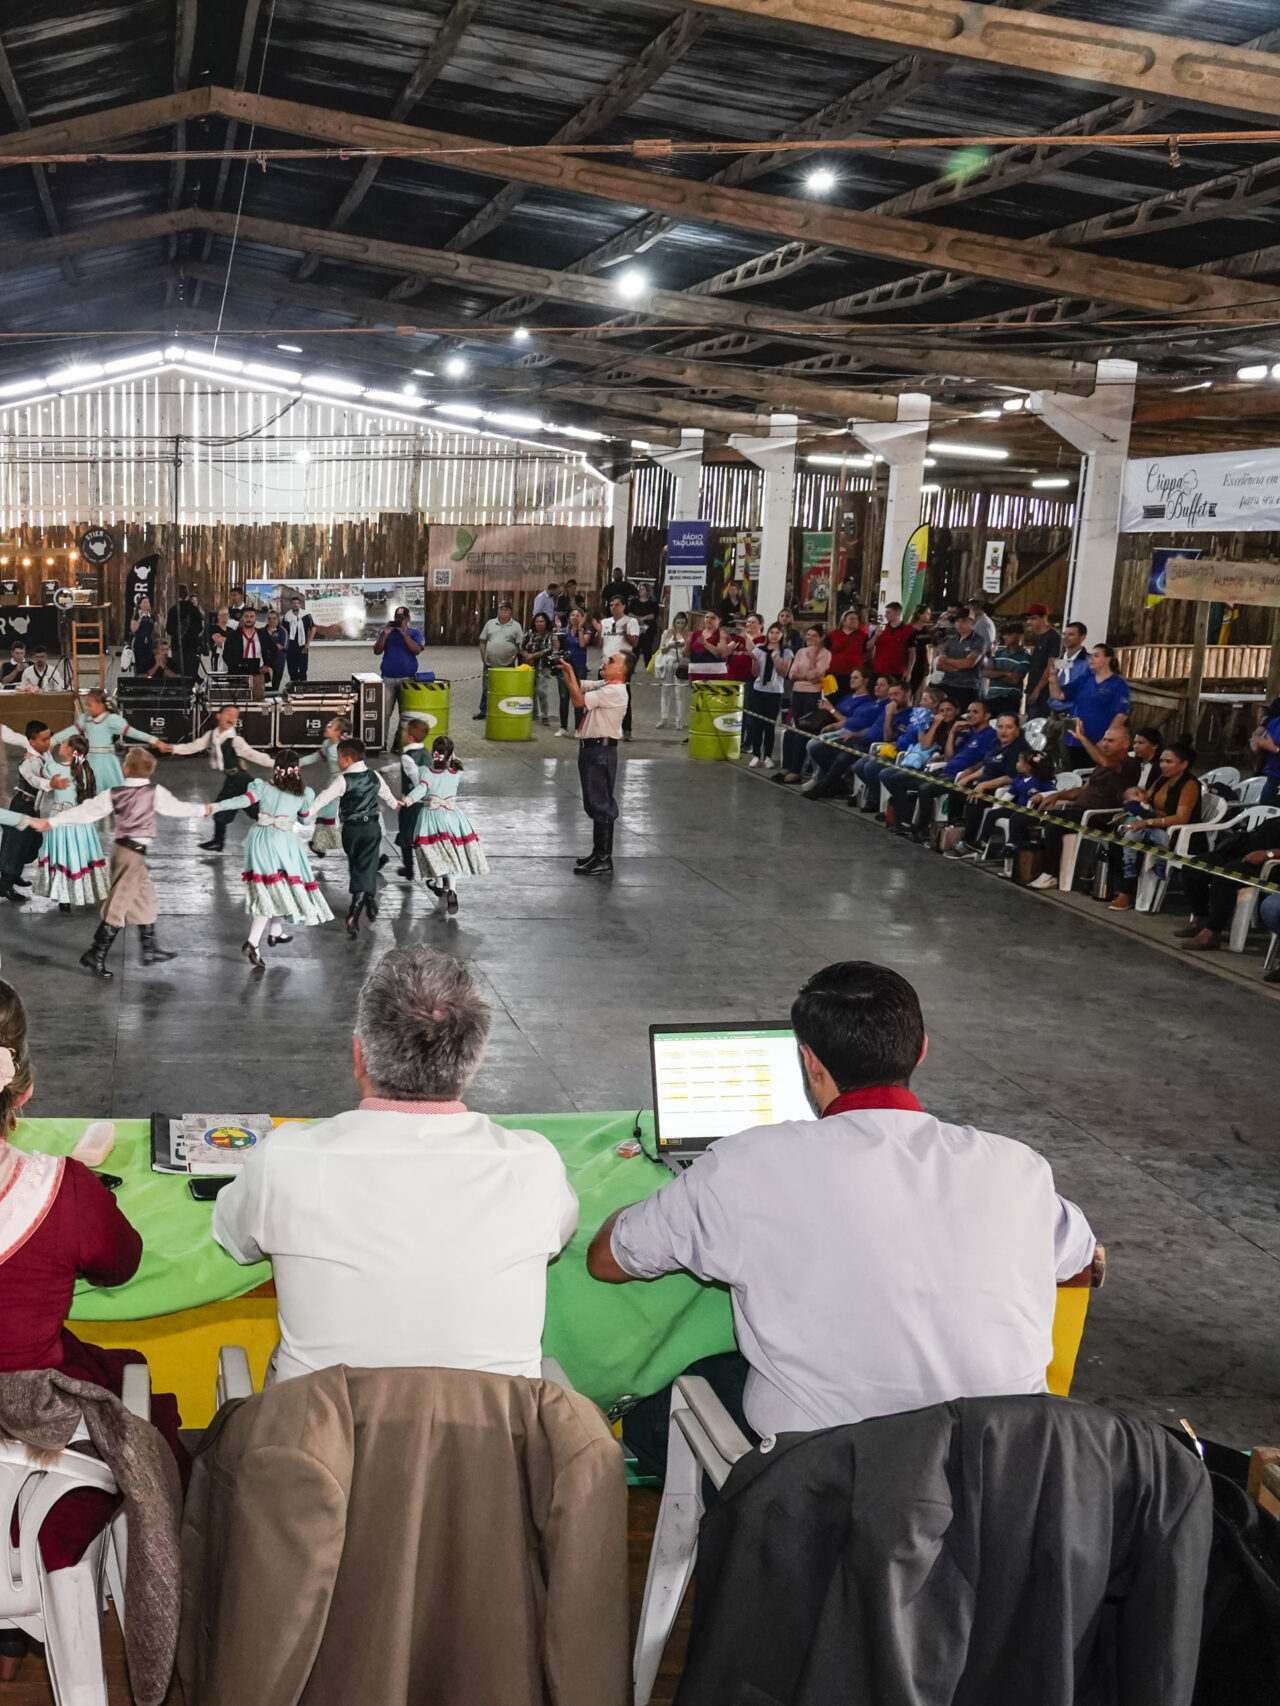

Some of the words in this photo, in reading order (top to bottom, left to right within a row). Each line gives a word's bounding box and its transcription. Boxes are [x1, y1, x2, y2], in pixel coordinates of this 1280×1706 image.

[1223, 472, 1264, 487] Excelência
[1266, 475, 1279, 484] em
[1166, 489, 1208, 528] Buffet
[1239, 496, 1259, 508] para
[85, 531, 104, 541] STIER
[682, 532, 703, 540] RÁDIO
[467, 550, 576, 565] ambente
